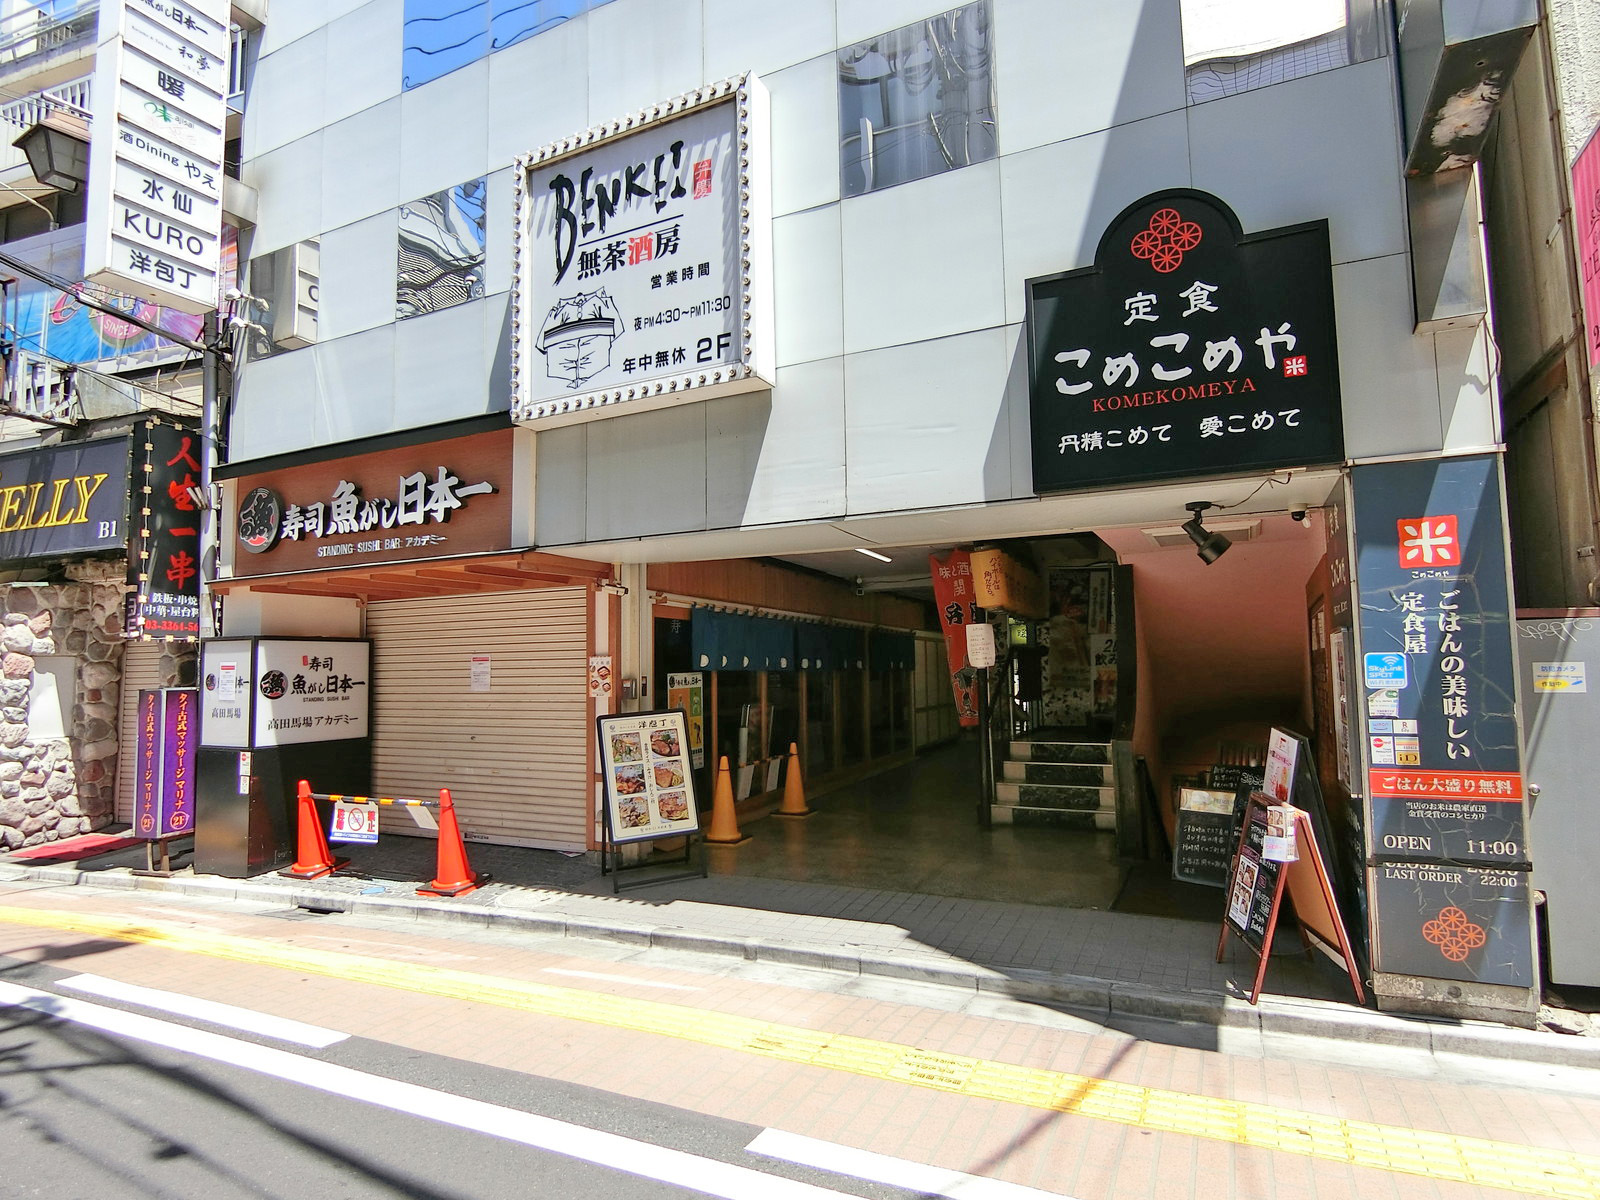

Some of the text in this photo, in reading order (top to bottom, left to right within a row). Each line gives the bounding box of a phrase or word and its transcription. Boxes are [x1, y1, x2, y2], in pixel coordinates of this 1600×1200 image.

[142, 0, 208, 35] がし日本一
[158, 70, 185, 101] 暖
[142, 179, 192, 215] 水仙
[124, 208, 204, 256] KURO
[577, 224, 681, 280] 無茶酒房
[129, 249, 197, 290] 洋包丁
[651, 262, 710, 290] 営業時間
[1123, 280, 1219, 326] 定食
[103, 318, 129, 336] SINCE
[633, 317, 643, 331] 夜
[622, 332, 732, 374] 年中無休 2F
[1054, 321, 1297, 395] こめこめや
[1285, 357, 1306, 376] 米
[1092, 377, 1257, 413] KOMEKOMEYA
[1058, 408, 1301, 454] 丹精こめて 愛こめて
[0, 473, 109, 533] ELLY
[280, 465, 493, 541] 寿司 魚がし日本一
[98, 520, 117, 539] B1
[1403, 521, 1453, 563] 米
[317, 535, 448, 558] STANDING SUSHI BAR アカデミー
[938, 560, 972, 579] 味と酒
[1400, 592, 1428, 655] 定食屋
[308, 655, 334, 672] 寿司
[1438, 589, 1471, 760] ごはんの美味しい
[291, 673, 366, 695] 魚がし日本一
[211, 707, 242, 719] 高田馬場
[1382, 776, 1513, 795] ごはん大盛り無料
[173, 815, 186, 826] 2F
[1405, 801, 1487, 813] 当店のお米は農家直送
[1408, 810, 1485, 820] 金賞受賞のコシヒカリ
[142, 818, 151, 828] 2F
[1383, 834, 1518, 856] OPEN 11:00
[1385, 868, 1417, 881] LAST
[1418, 869, 1463, 884] ORDER
[1480, 875, 1518, 888] 22:00
